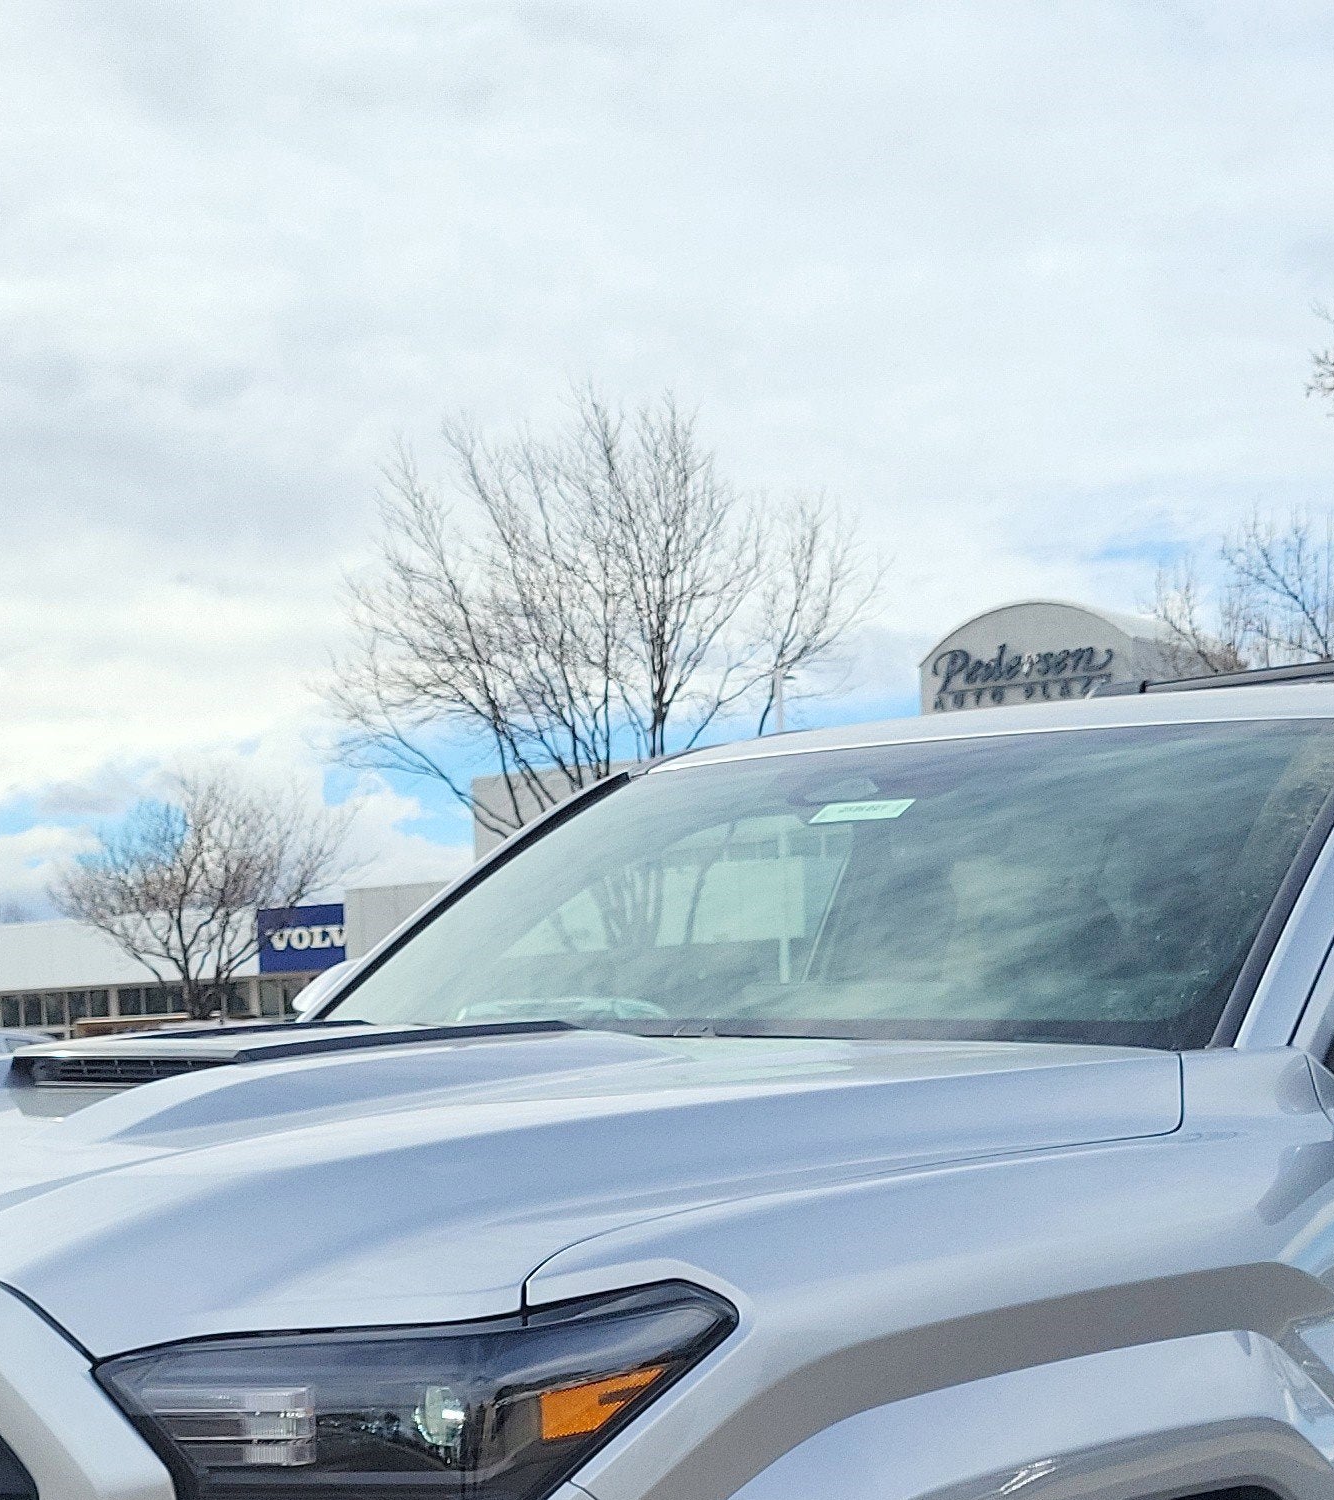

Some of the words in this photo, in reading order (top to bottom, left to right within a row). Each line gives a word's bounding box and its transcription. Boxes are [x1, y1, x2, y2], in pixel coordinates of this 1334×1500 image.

[932, 643, 1113, 696] Pedersen
[934, 685, 1006, 711] AUTO
[267, 925, 347, 951] VOLV
